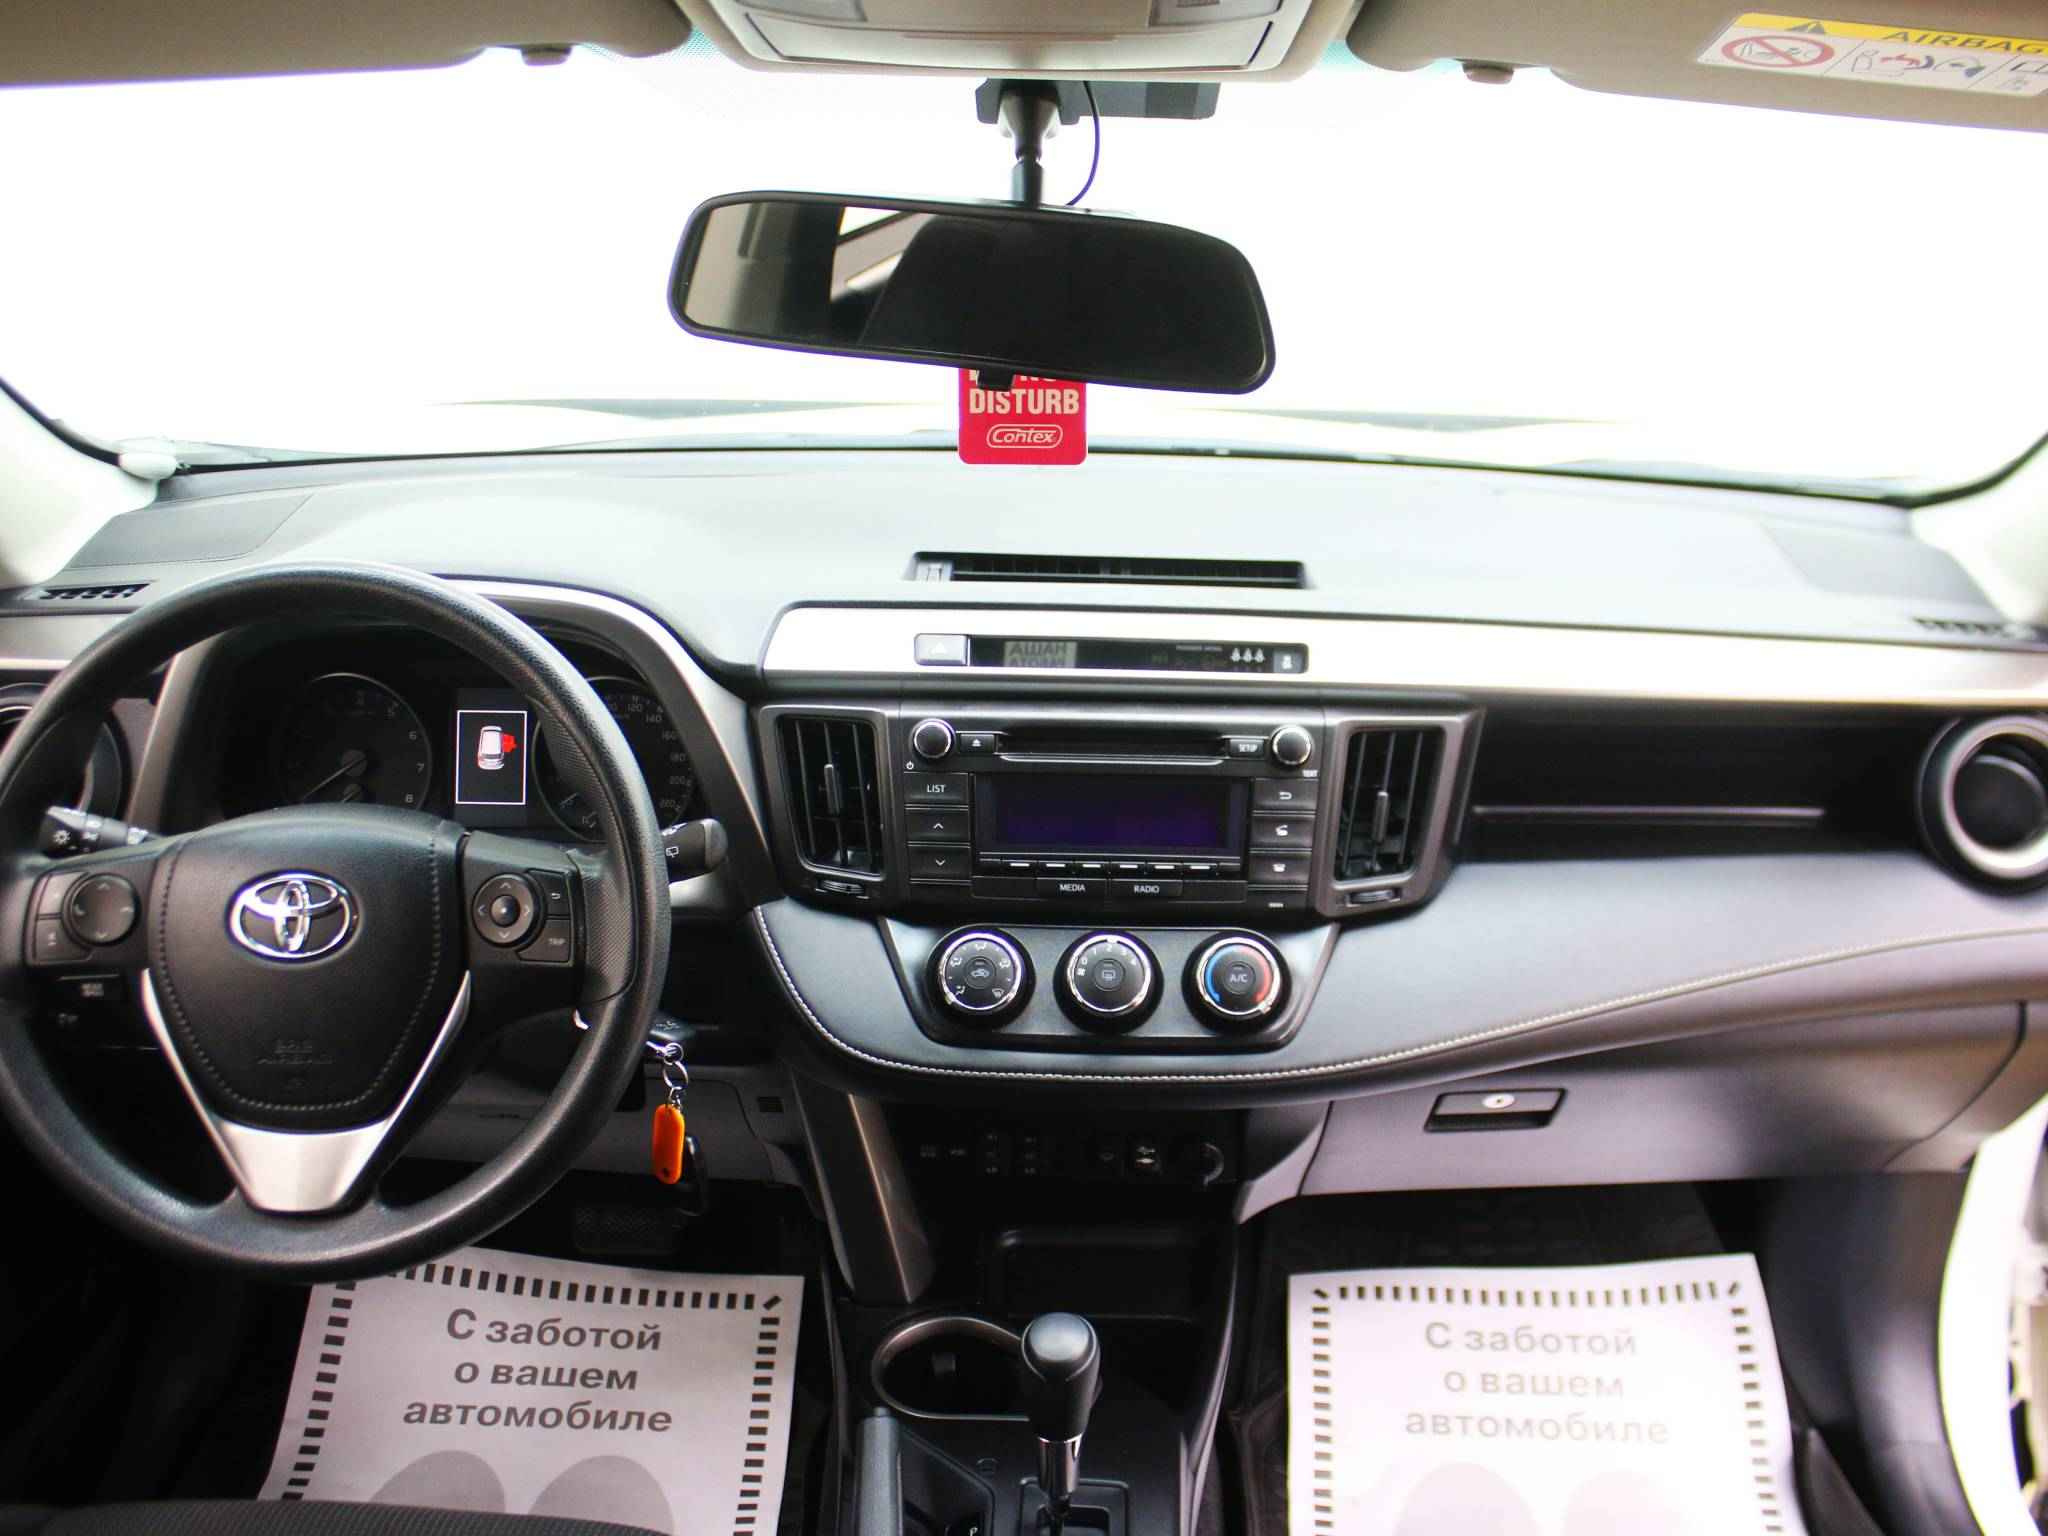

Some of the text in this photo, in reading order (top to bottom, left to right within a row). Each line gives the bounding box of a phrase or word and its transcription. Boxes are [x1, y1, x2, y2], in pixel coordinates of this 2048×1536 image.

[1881, 31, 2046, 54] AIRBAG
[968, 388, 1081, 415] DISTURB
[992, 427, 1058, 445] Contex
[416, 762, 425, 773] 7
[926, 783, 946, 793] LIST
[1059, 883, 1086, 892] MEDIA
[1133, 884, 1160, 894] RADIO
[1230, 973, 1249, 983] A/C
[446, 1308, 662, 1351] С заботой
[1424, 1322, 1638, 1356] С заботой
[454, 1363, 638, 1390] о вашем
[1444, 1372, 1625, 1398] о вашем
[402, 1401, 673, 1433] автомобиле
[1405, 1412, 1670, 1444] автомобиле
